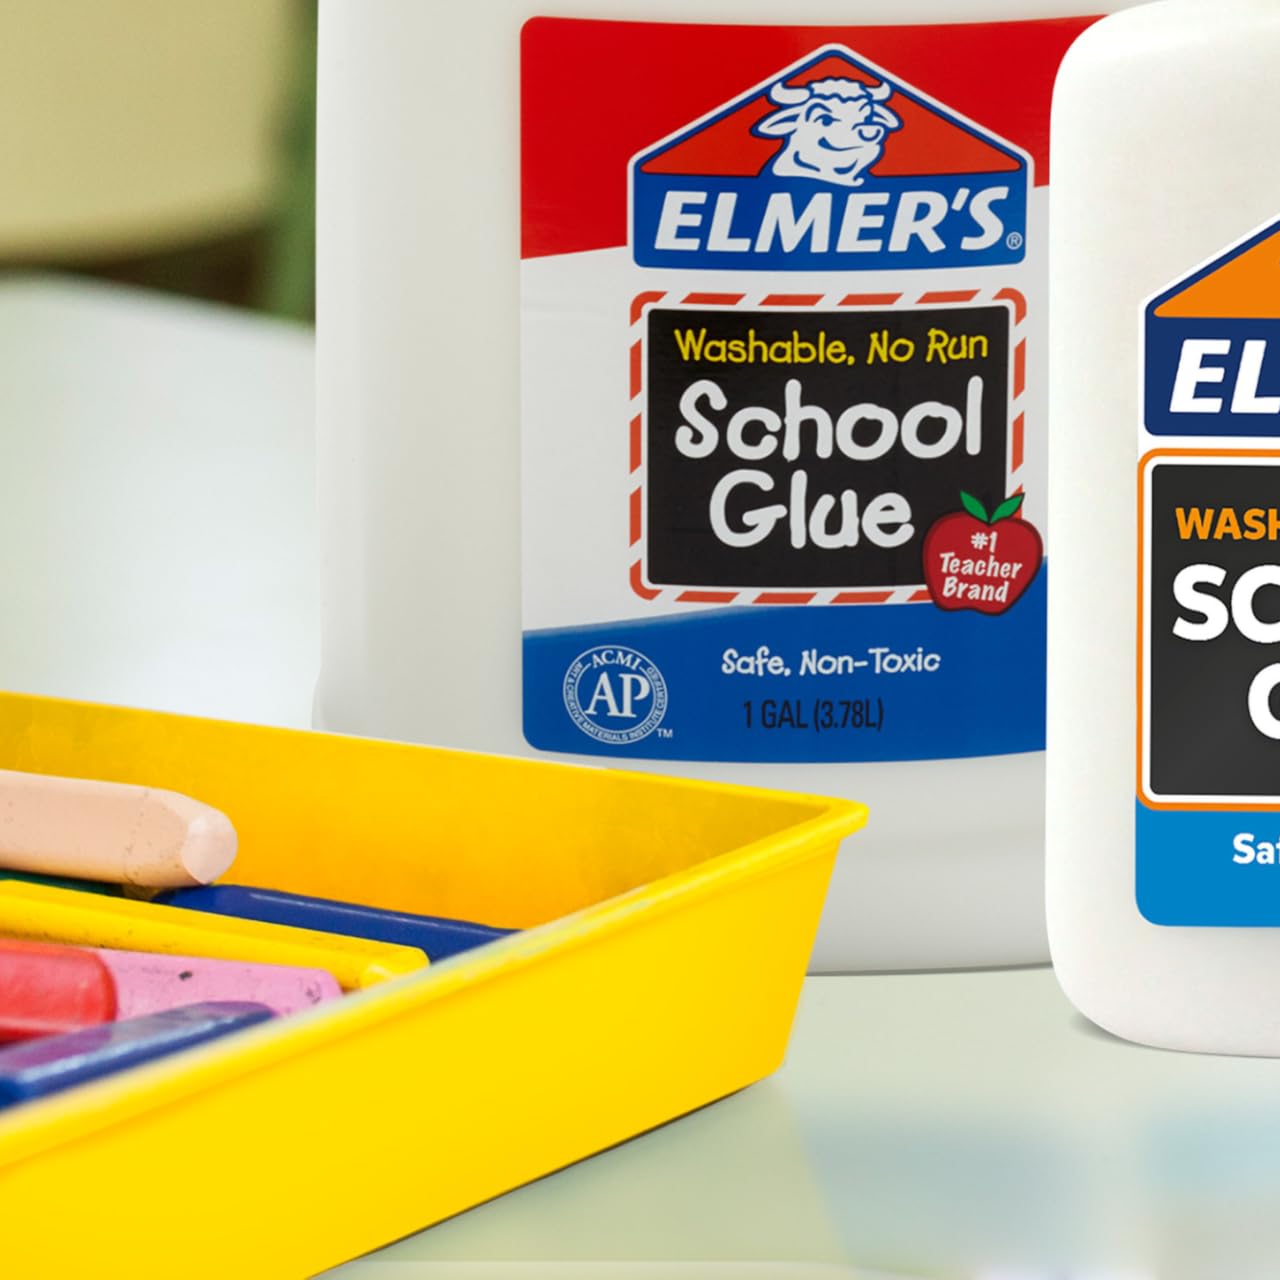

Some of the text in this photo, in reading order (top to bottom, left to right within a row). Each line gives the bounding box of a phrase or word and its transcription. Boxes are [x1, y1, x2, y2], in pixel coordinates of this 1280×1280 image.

[654, 187, 1009, 253] ELMER'S
[674, 328, 988, 364] Washable, No Run
[675, 375, 983, 462] School
[710, 469, 915, 549] Glue
[971, 531, 998, 553] #1
[940, 552, 1023, 579] Teacher
[942, 576, 1009, 603] Brand
[592, 650, 641, 670] ACMI
[721, 647, 940, 677] Safe, Non-Toxic
[584, 671, 650, 718] AP
[743, 698, 884, 733] 1 GAL (3.78L)
